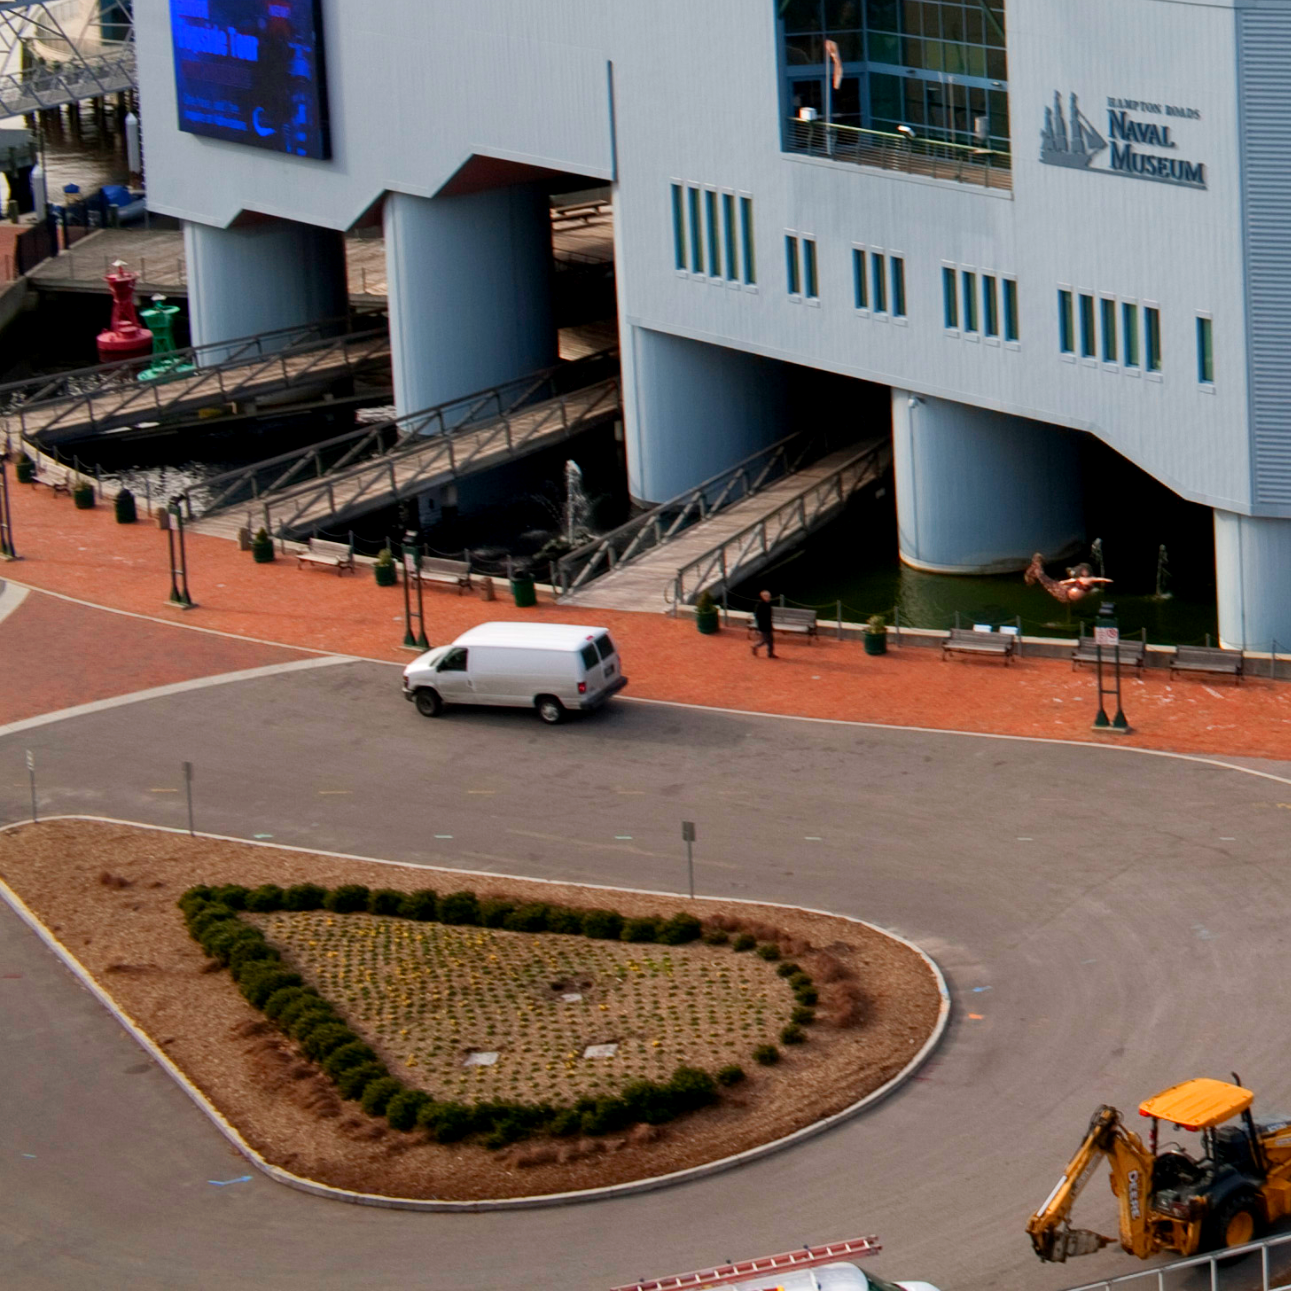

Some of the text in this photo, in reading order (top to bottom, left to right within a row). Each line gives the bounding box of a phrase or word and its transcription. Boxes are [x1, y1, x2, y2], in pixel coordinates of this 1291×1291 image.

[1107, 97, 1201, 120] HAMPTON ROADS
[1107, 109, 1175, 148] NAVAL
[1109, 141, 1205, 184] MUSEUM
[1128, 1169, 1141, 1221] DEERE
